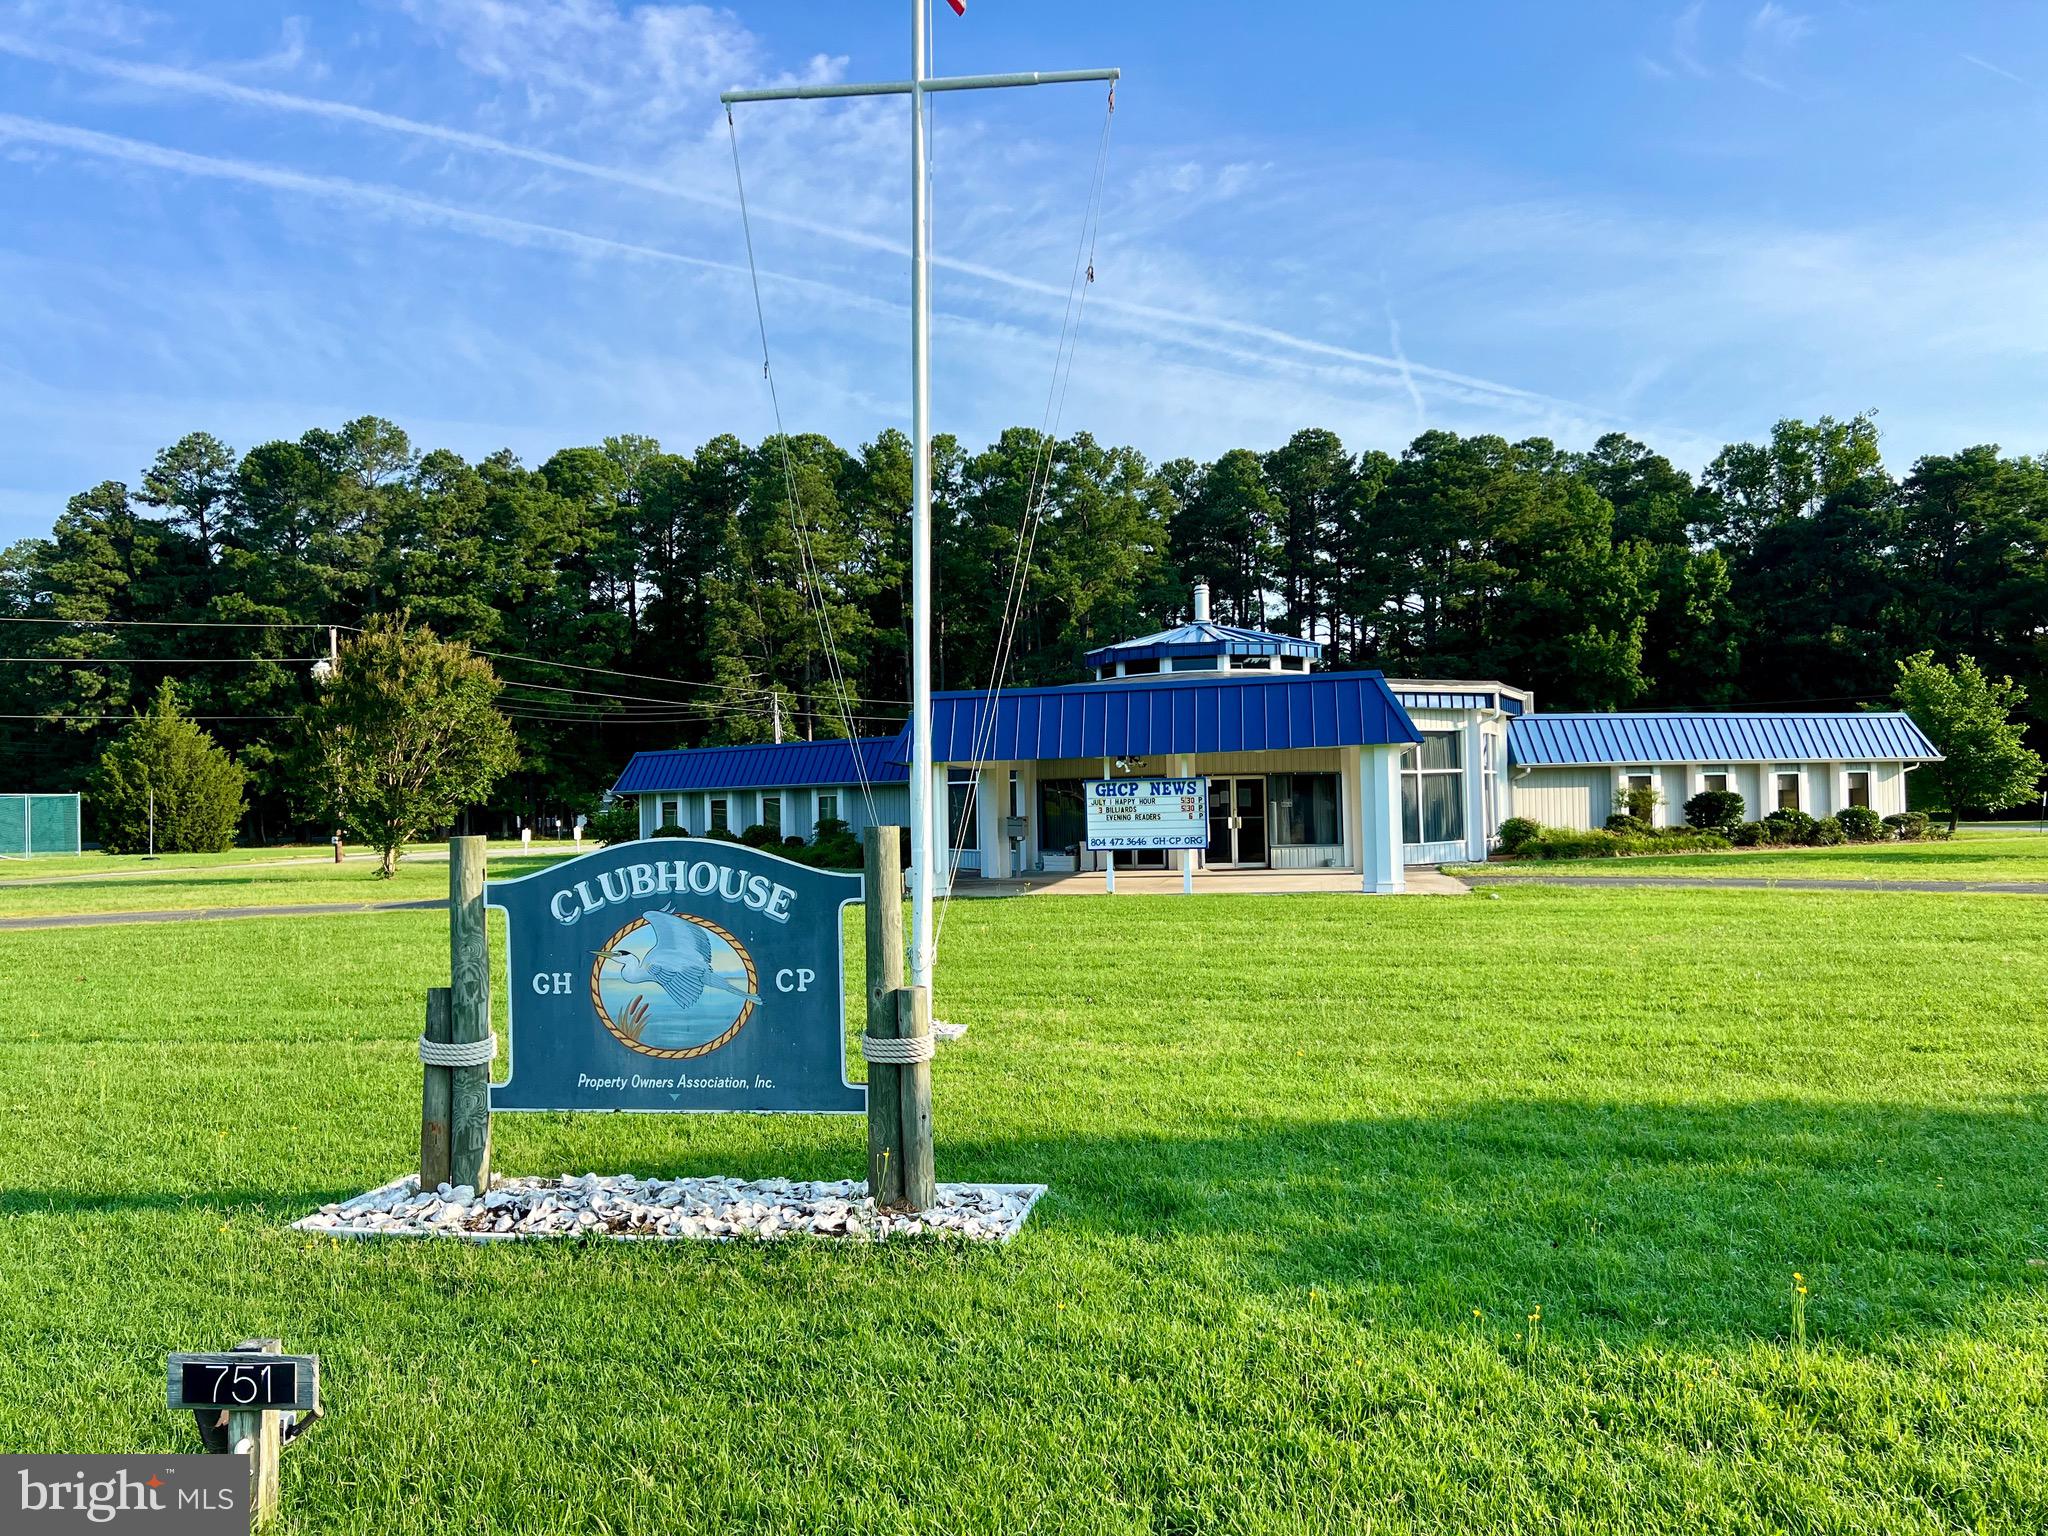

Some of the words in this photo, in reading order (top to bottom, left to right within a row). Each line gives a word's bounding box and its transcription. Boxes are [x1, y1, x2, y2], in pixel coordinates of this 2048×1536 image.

[1095, 782, 1139, 797] GHCP
[1149, 781, 1197, 795] NEWS
[1091, 798, 1106, 806] JULY
[1139, 797, 1156, 805] HOUR
[1134, 813, 1161, 821] READERS
[1090, 838, 1106, 846] 804
[1109, 838, 1124, 846] 472
[1126, 837, 1147, 846] 3646
[550, 860, 798, 925] CLUBHOUSE
[532, 972, 572, 995] GH
[775, 968, 816, 993] CP
[577, 1073, 628, 1090] Property
[631, 1074, 674, 1089] Owners
[676, 1073, 750, 1090] Association,
[754, 1074, 776, 1089] Inc.
[205, 1364, 272, 1404] 751
